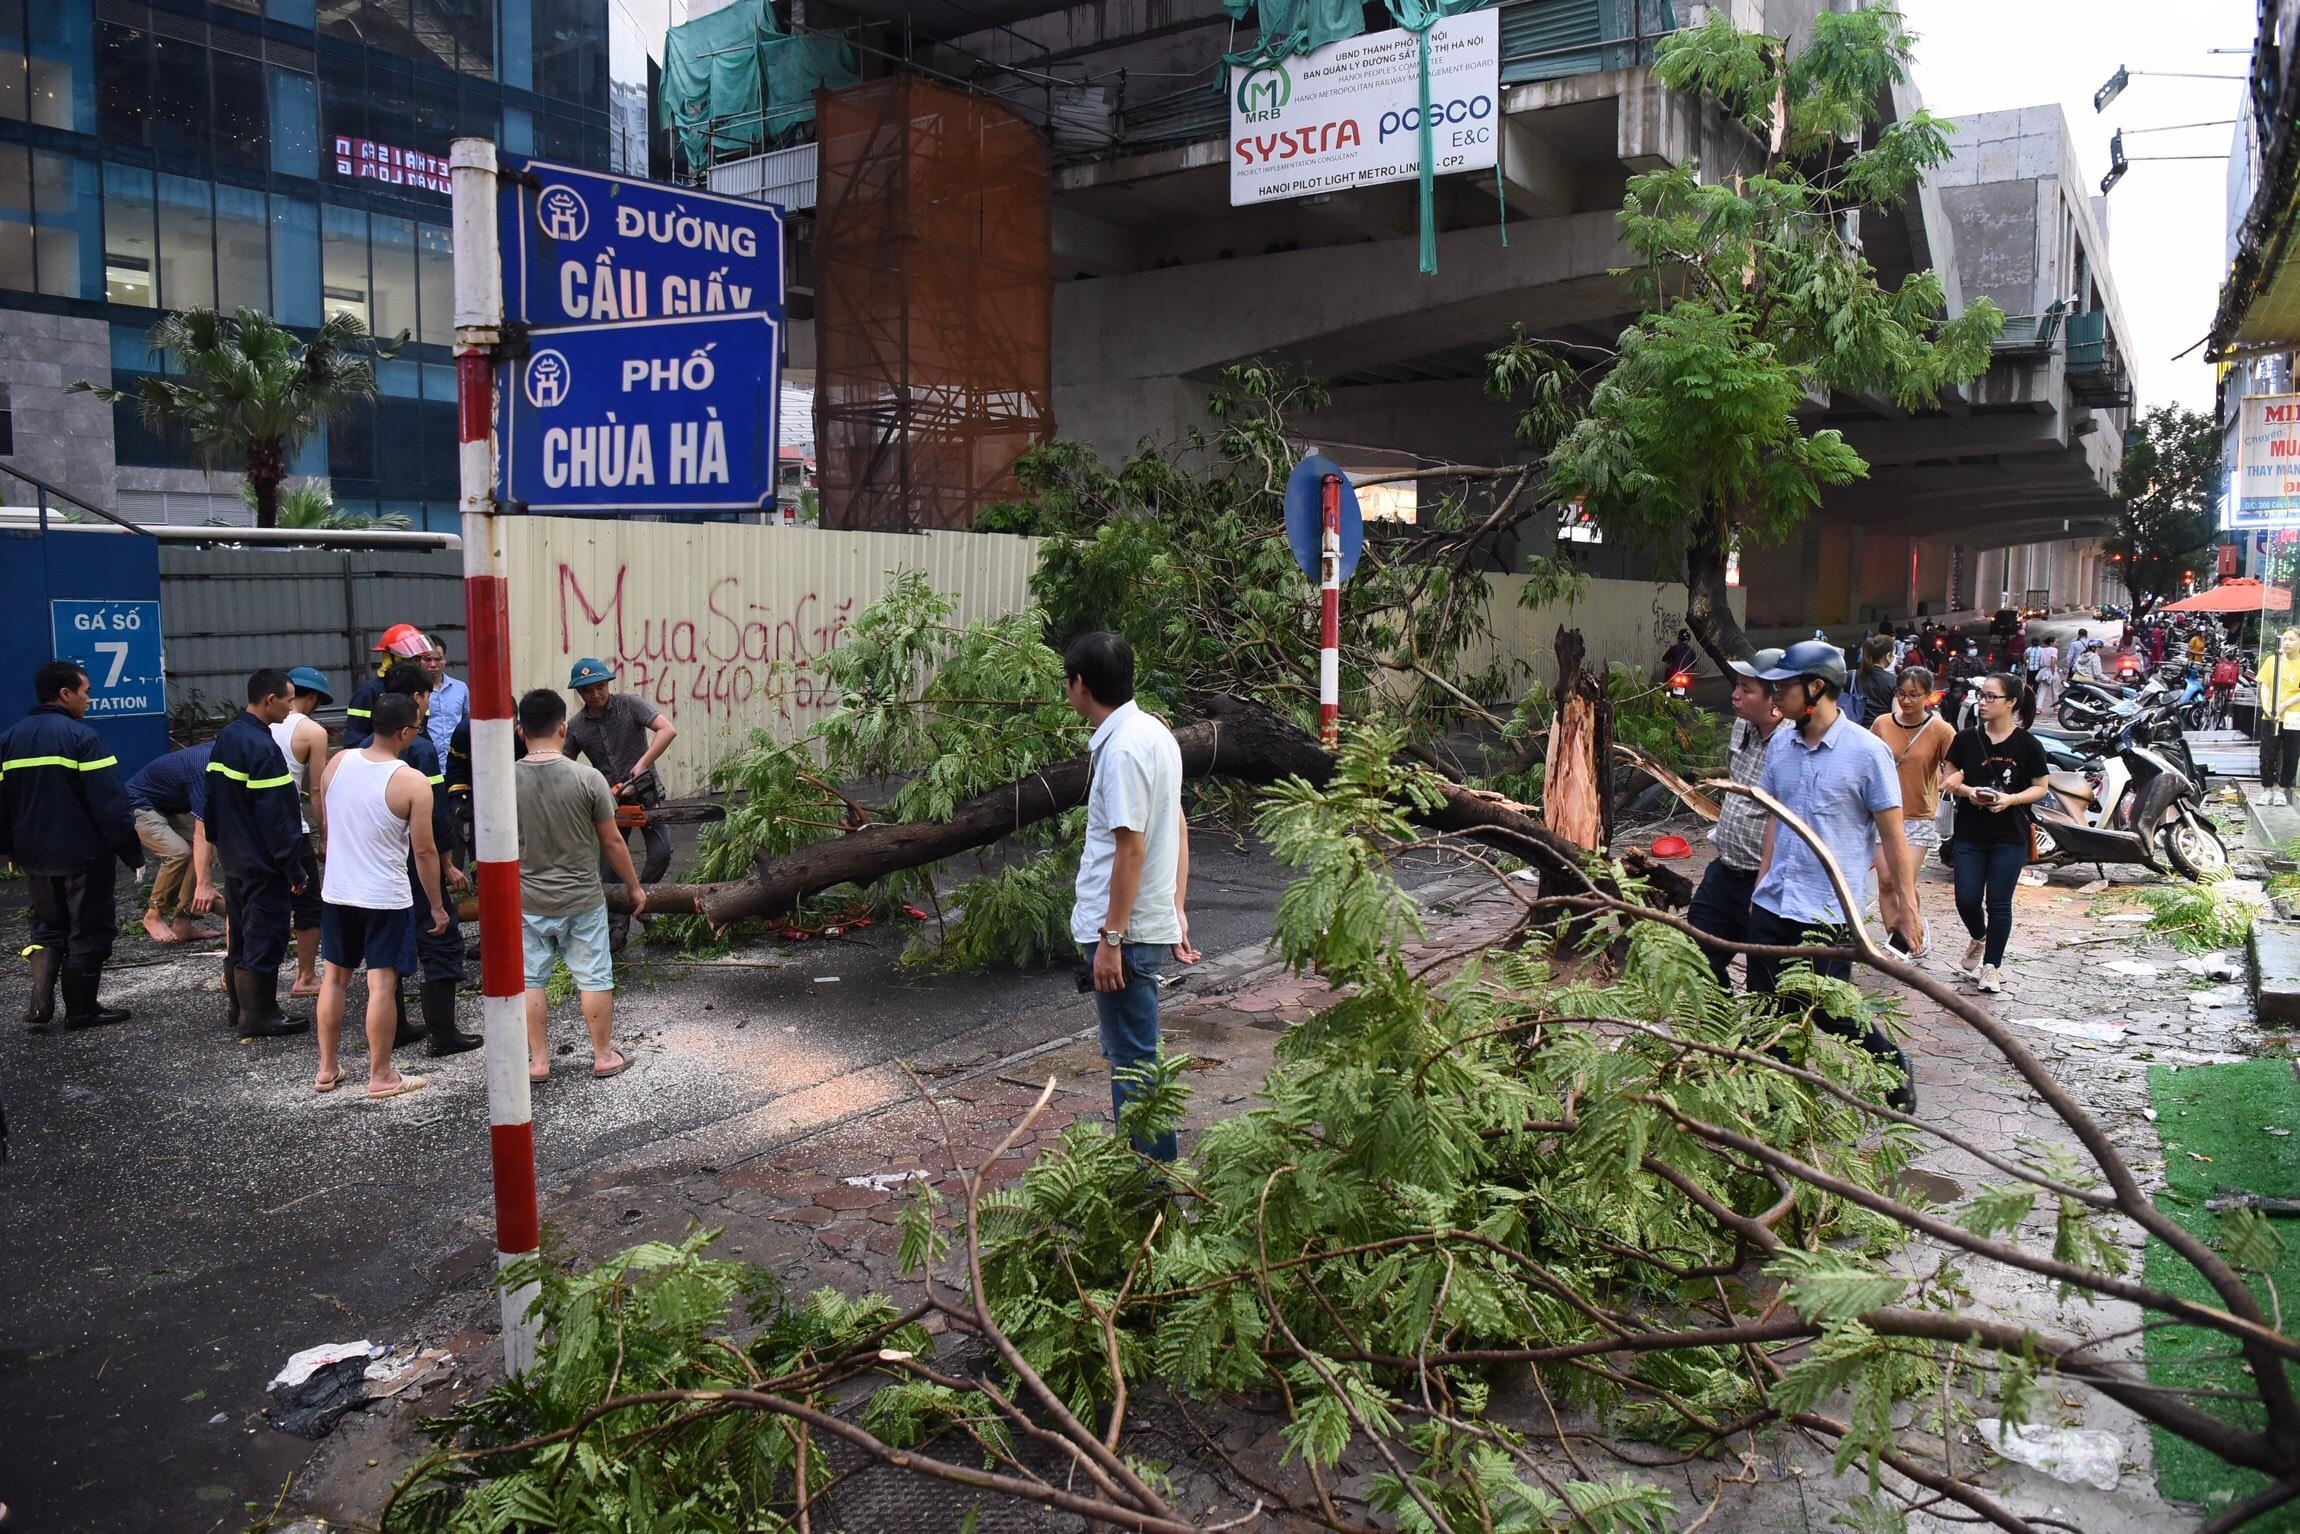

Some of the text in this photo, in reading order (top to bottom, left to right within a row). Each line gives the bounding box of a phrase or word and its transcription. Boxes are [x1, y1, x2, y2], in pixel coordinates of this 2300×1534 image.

[1336, 49, 1360, 61] UBND
[1294, 93, 1317, 104] HANOI
[1318, 82, 1374, 99] METROPOLITAN
[1375, 75, 1407, 87] RAILWAY
[1465, 59, 1494, 71] BOARD
[1303, 69, 1321, 80] BAN
[1338, 73, 1361, 83] HANOI
[1245, 108, 1281, 124] MRB
[1452, 127, 1490, 147] E&C
[1236, 151, 1359, 177] PROJECT IMPLEMENTATION CONSULTANT
[1259, 182, 1290, 196] HANOI
[1292, 177, 1322, 191] PILOT
[1325, 172, 1356, 186] LIGHT
[1358, 165, 1397, 180] METRO
[1442, 155, 1464, 167] CP2
[616, 203, 757, 257] ĐƯỜNG
[560, 246, 648, 320] CẦU
[622, 343, 716, 392] PHỐ
[543, 406, 730, 489] CHÙA HÀ
[2247, 465, 2272, 477] THAY
[112, 607, 141, 631] SỐ
[559, 563, 697, 664] Mua
[94, 641, 129, 688] 7
[86, 696, 147, 711] TATION
